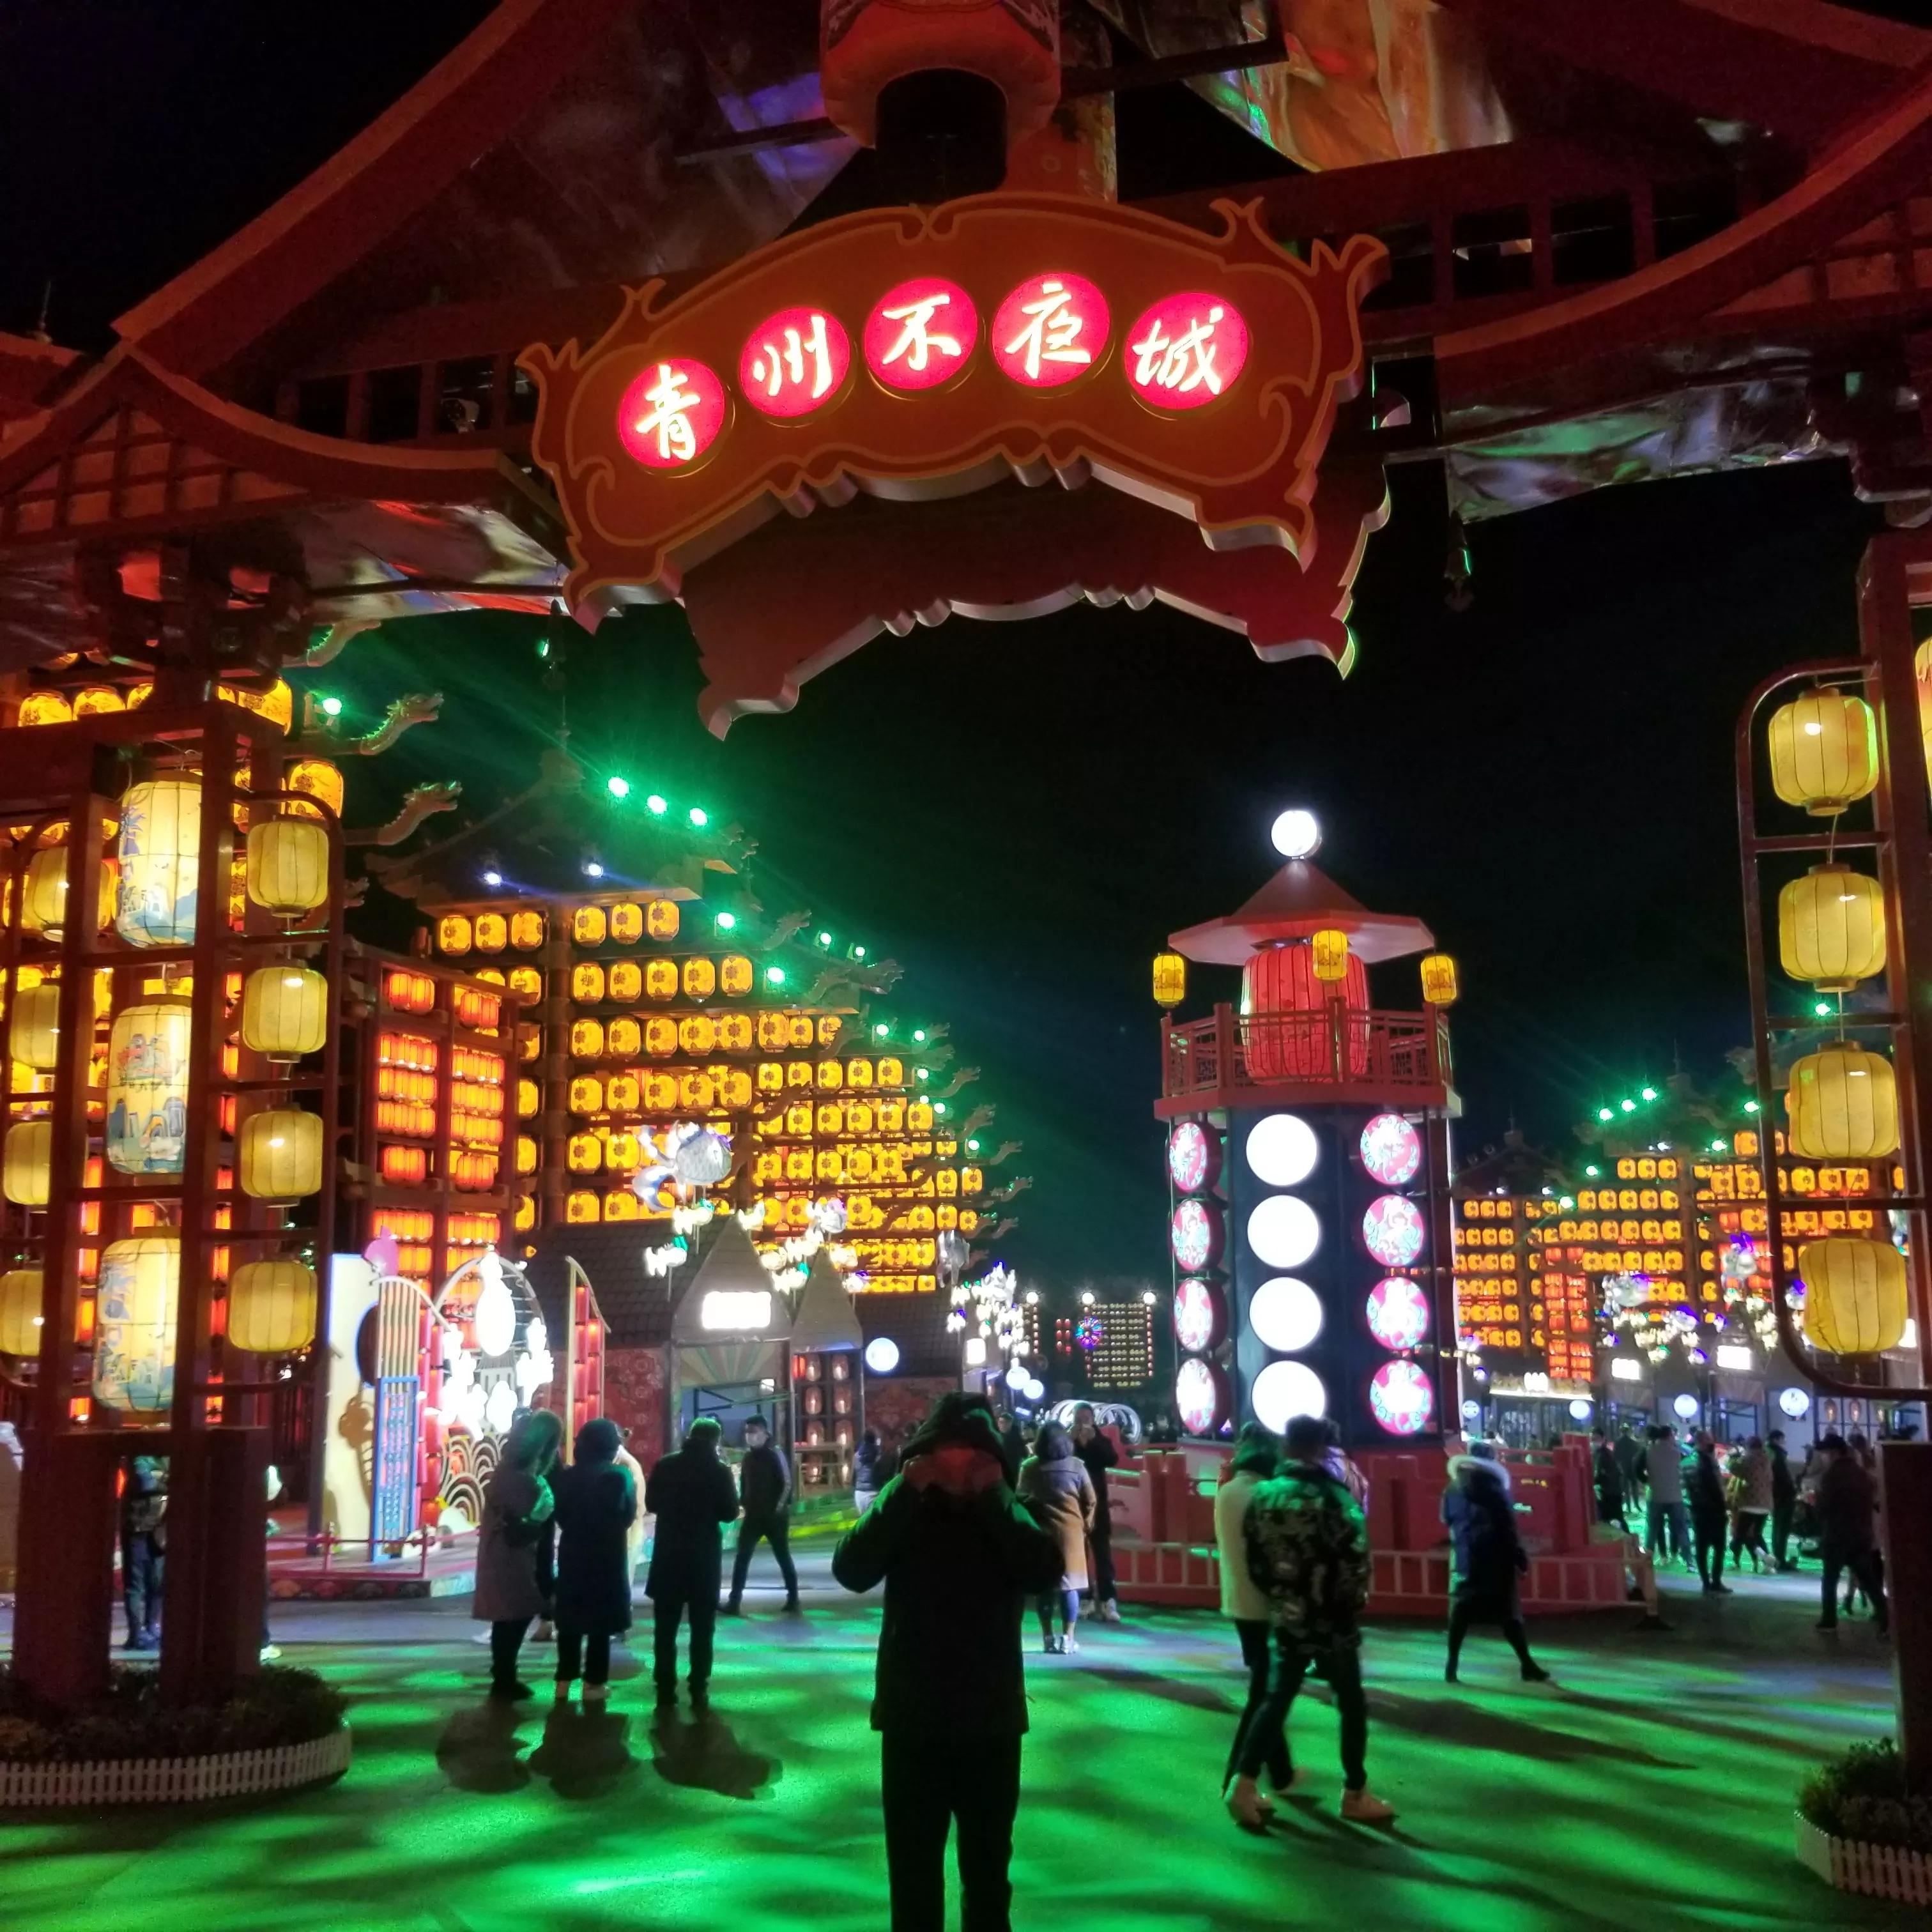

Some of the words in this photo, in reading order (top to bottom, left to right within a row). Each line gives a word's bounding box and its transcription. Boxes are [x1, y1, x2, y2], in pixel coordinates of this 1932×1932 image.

[634, 280, 1225, 461] 青州不夜城
